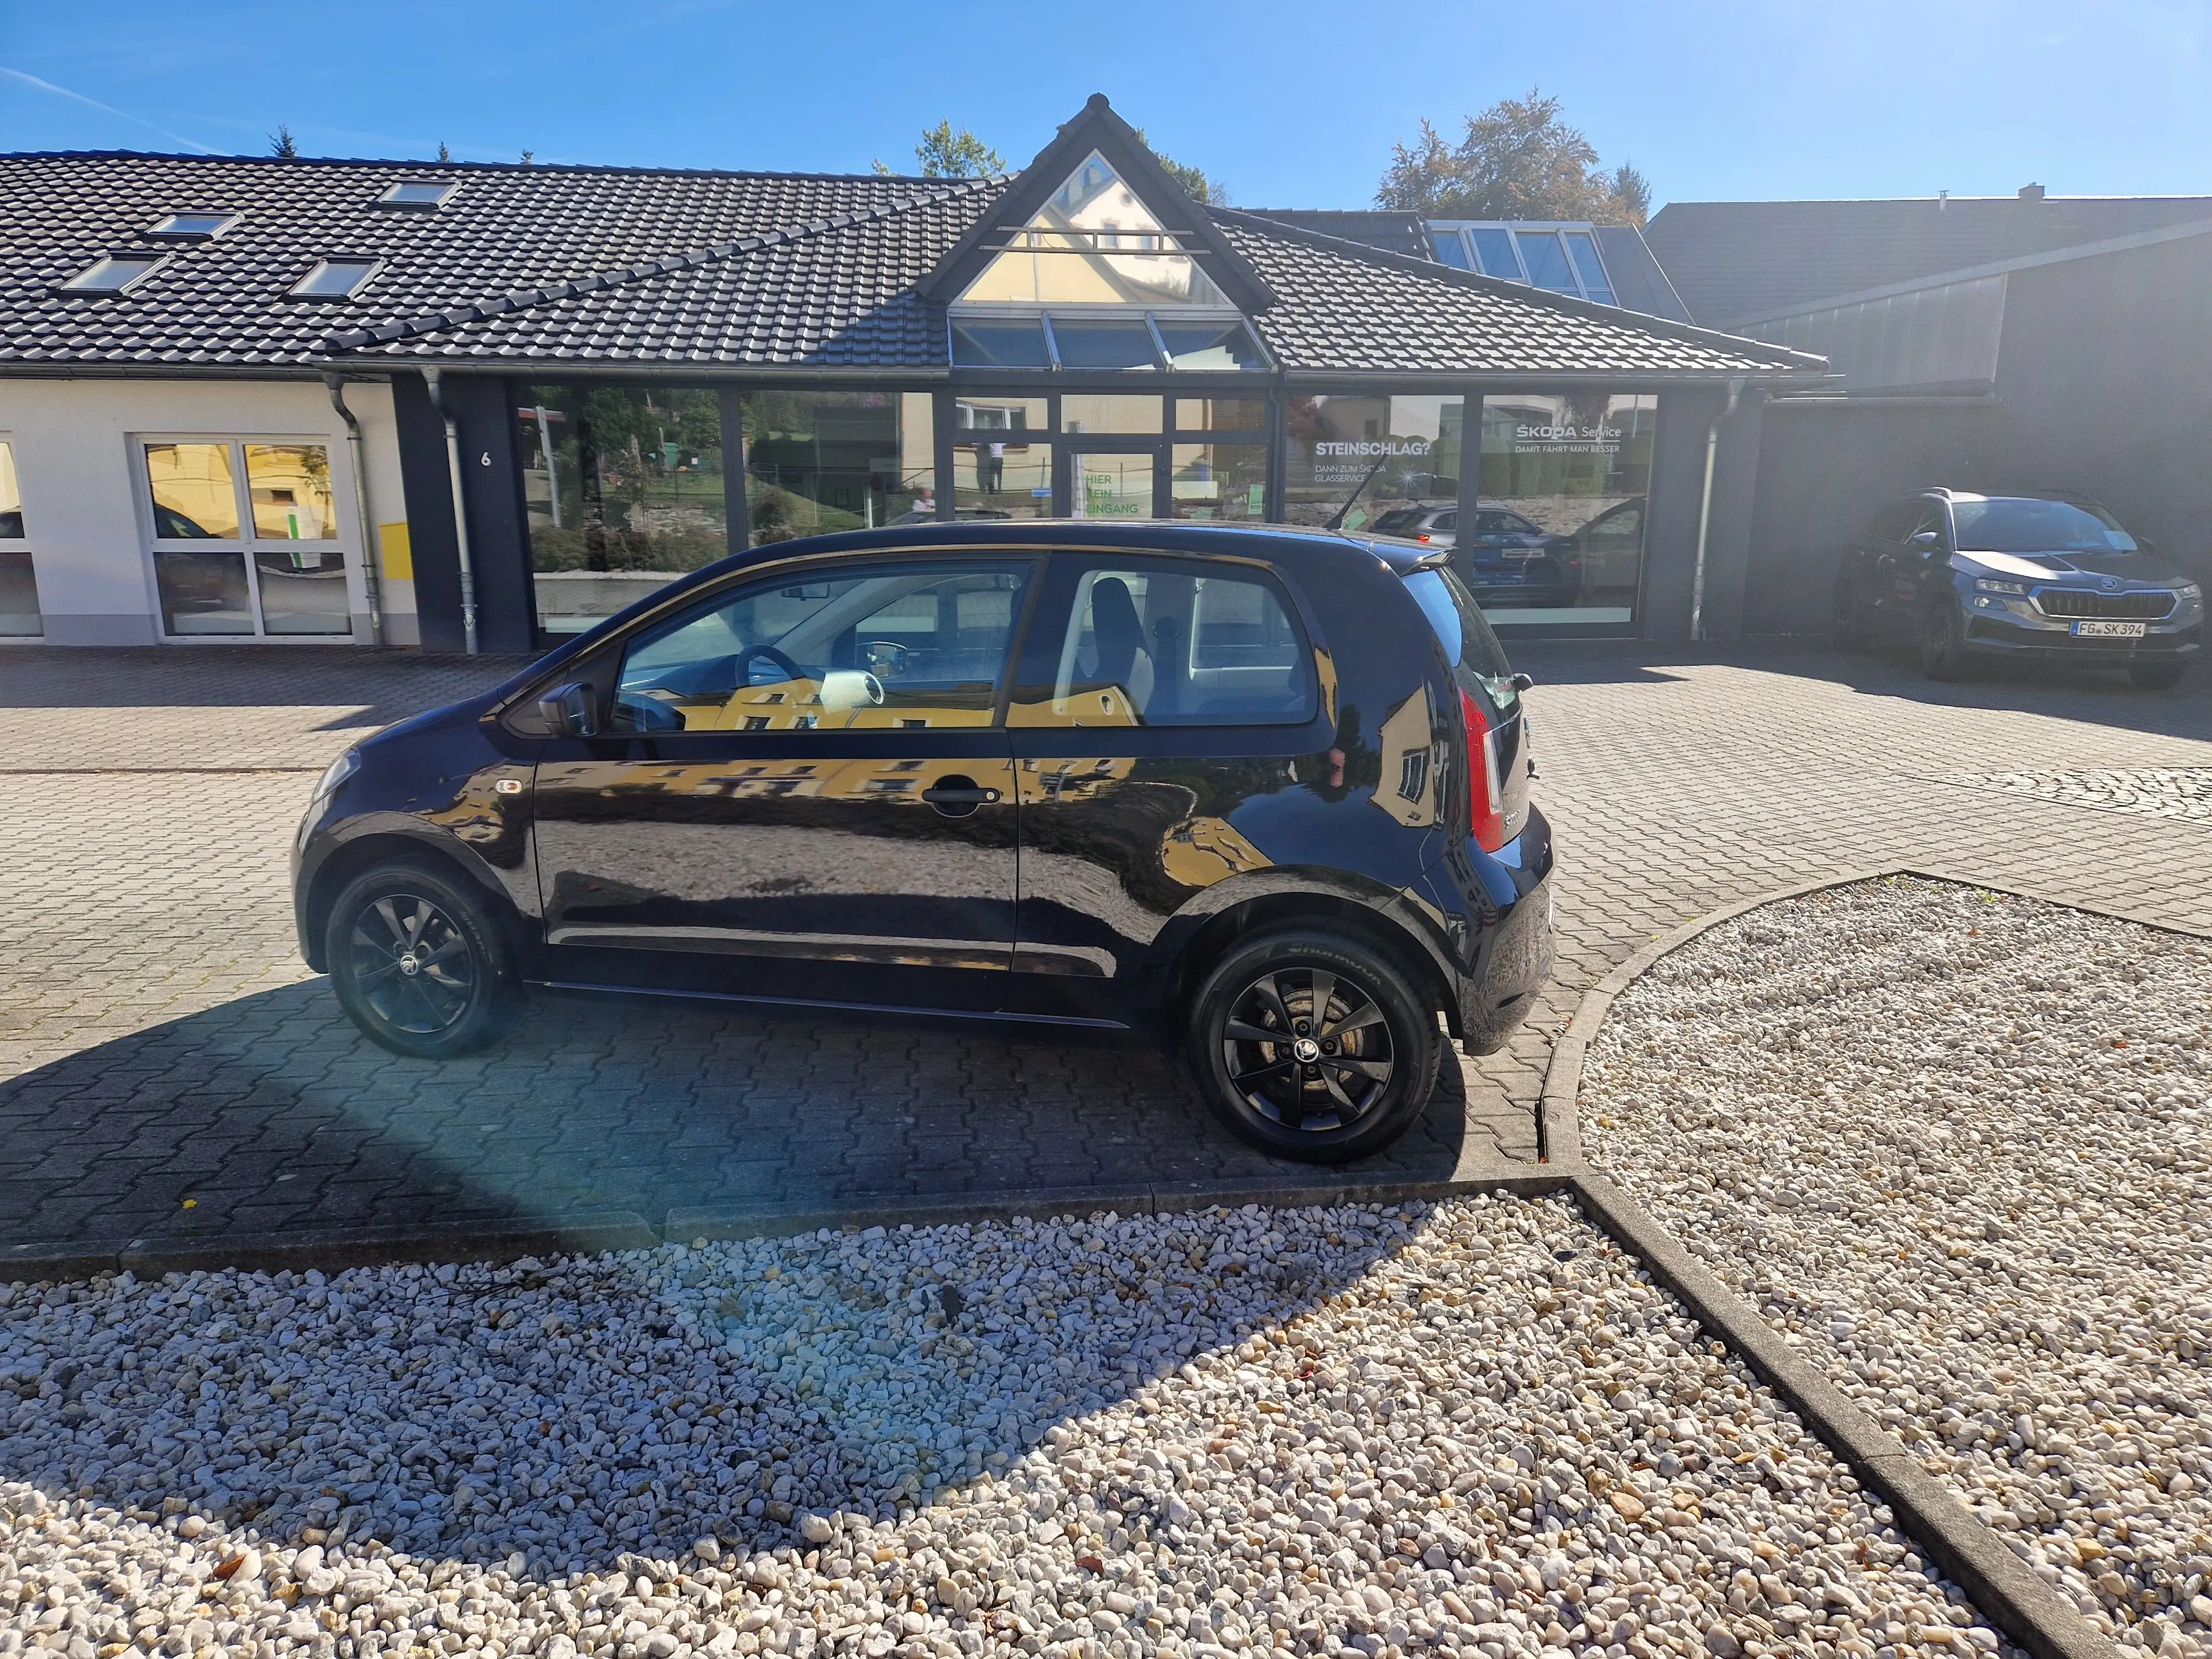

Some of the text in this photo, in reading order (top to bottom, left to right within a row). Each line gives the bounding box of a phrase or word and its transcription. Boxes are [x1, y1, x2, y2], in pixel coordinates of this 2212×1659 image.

[1517, 424, 1621, 437] ŠKODA Service
[1315, 442, 1431, 456] STEINSCHLAG?
[1543, 444, 1568, 453] FÄHRT
[481, 452, 491, 466] 6
[1086, 475, 1112, 484] HIER
[1086, 504, 1138, 513] EINGANG
[2080, 623, 2096, 634] FG
